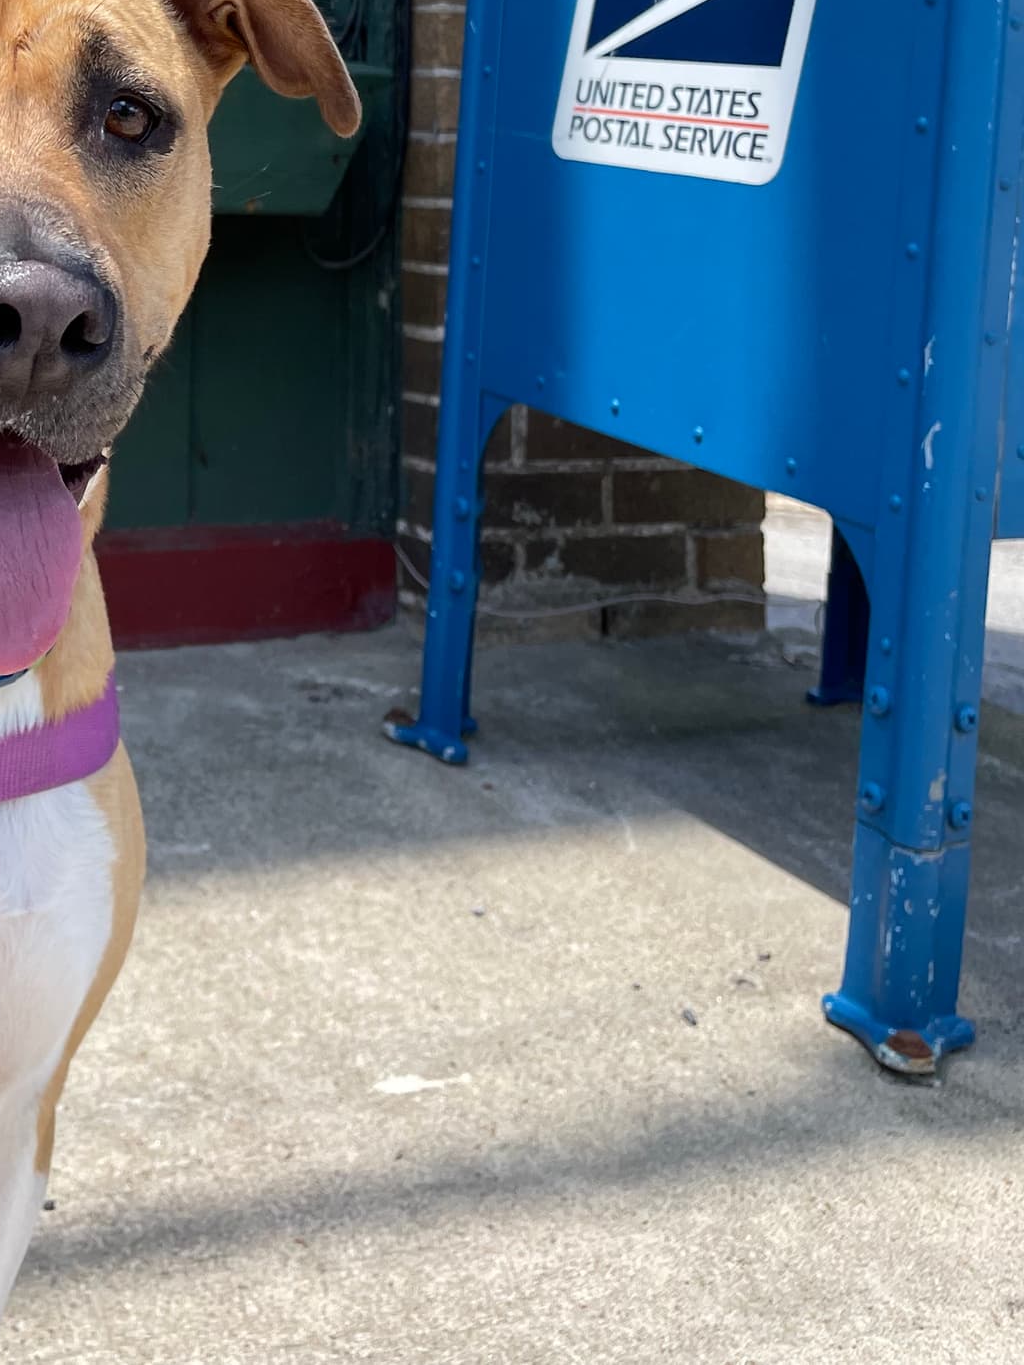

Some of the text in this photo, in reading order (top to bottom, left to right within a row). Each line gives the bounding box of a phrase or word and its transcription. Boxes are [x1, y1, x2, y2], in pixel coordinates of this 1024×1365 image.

[576, 79, 763, 119] UNITED STATES
[568, 115, 769, 162] POSTAL SERVICE
